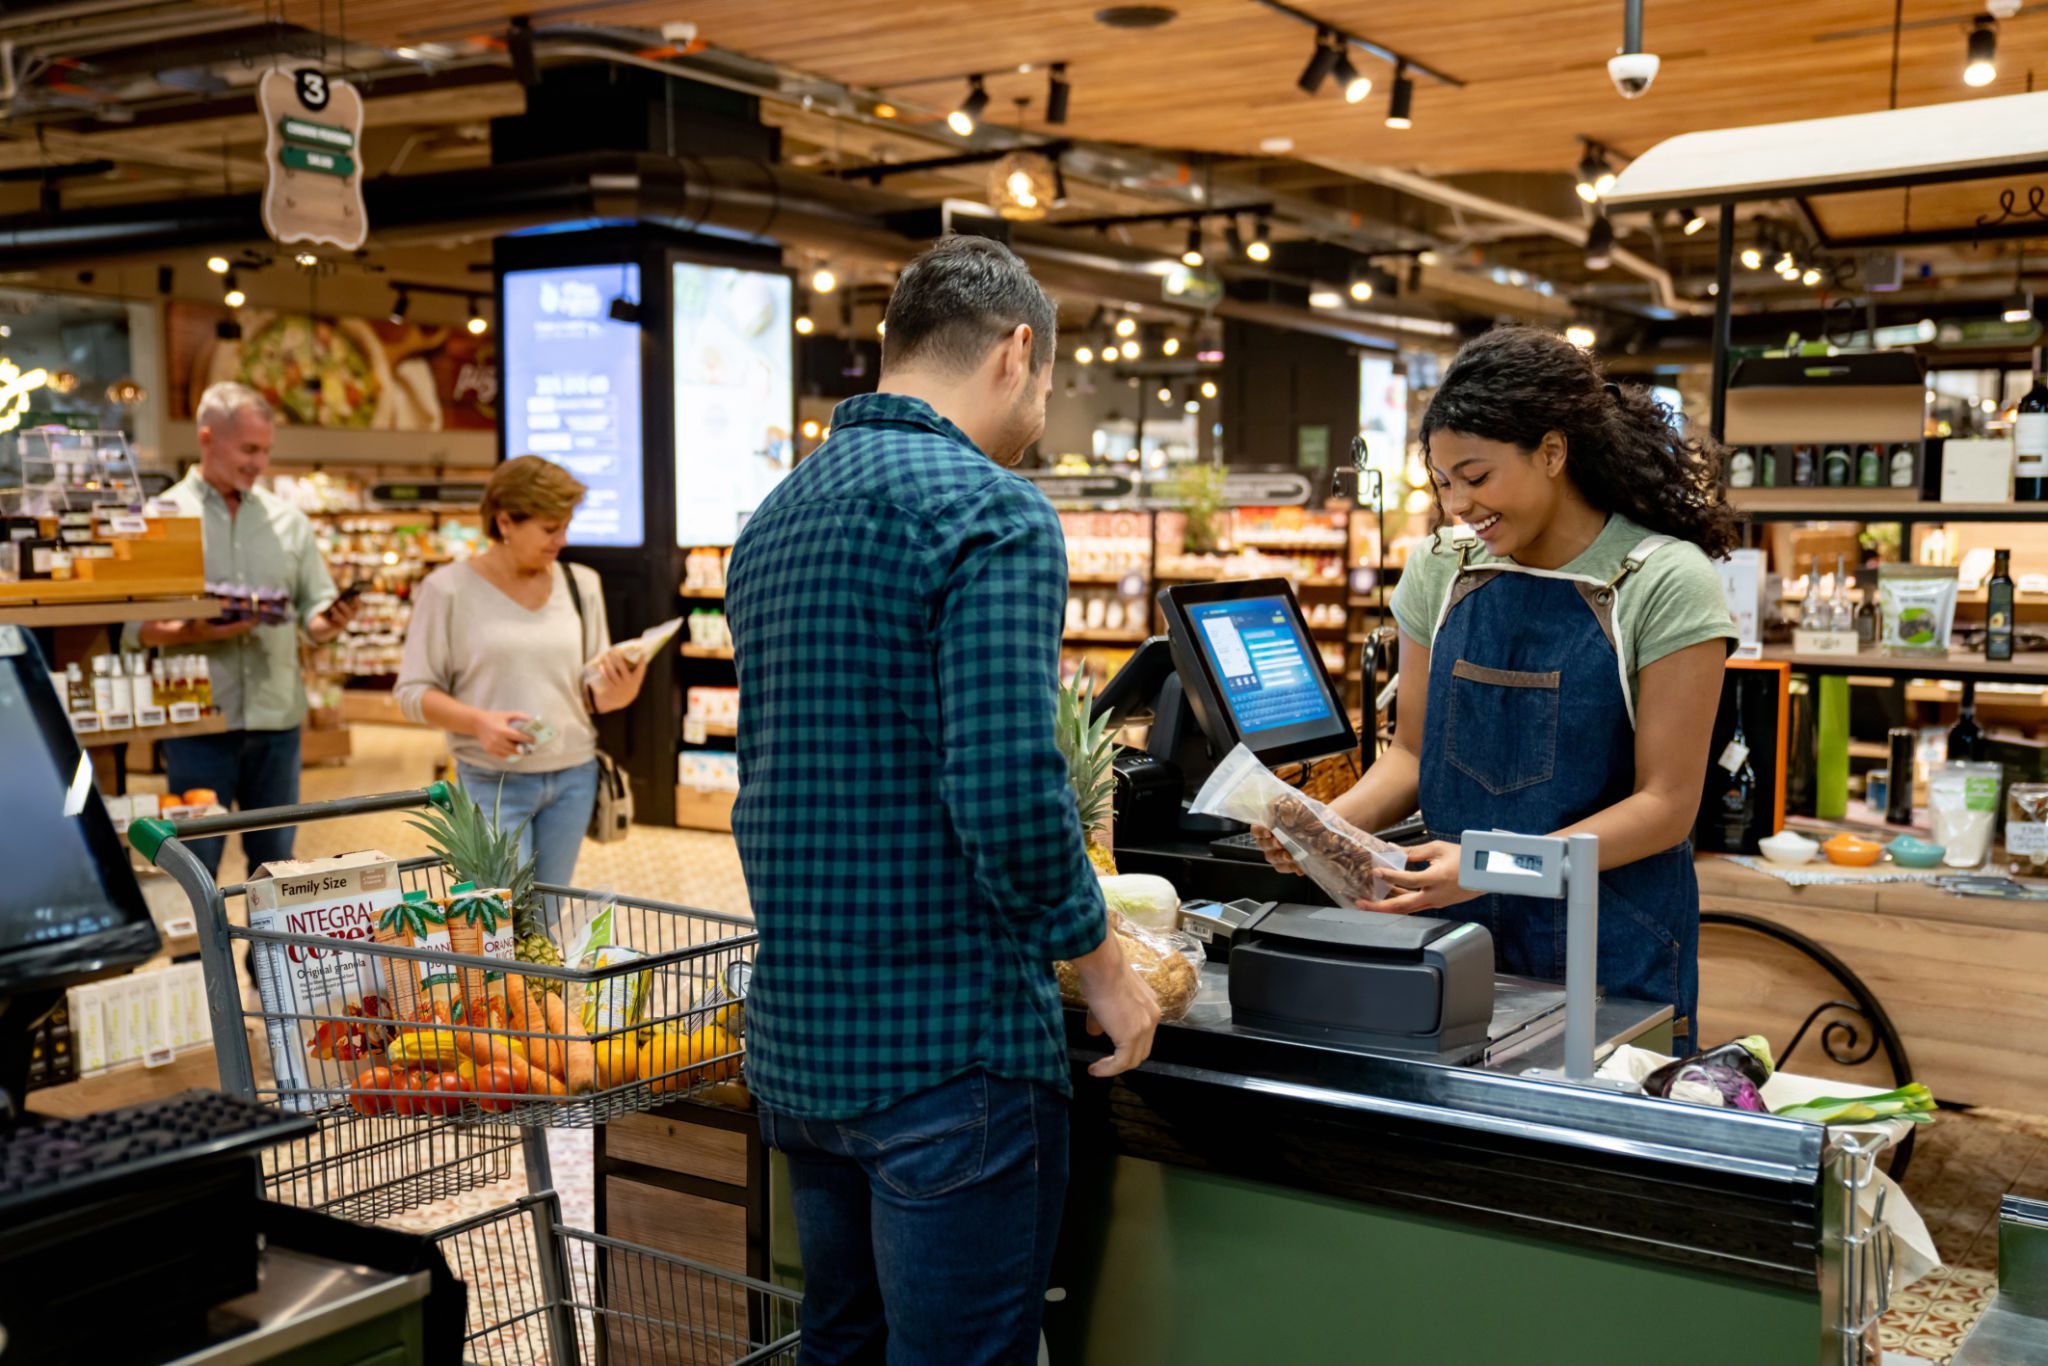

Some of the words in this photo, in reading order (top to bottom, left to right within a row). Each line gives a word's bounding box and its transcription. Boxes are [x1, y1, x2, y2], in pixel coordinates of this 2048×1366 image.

[303, 73, 326, 104] 3
[281, 880, 320, 896] Family
[323, 877, 347, 890] Size
